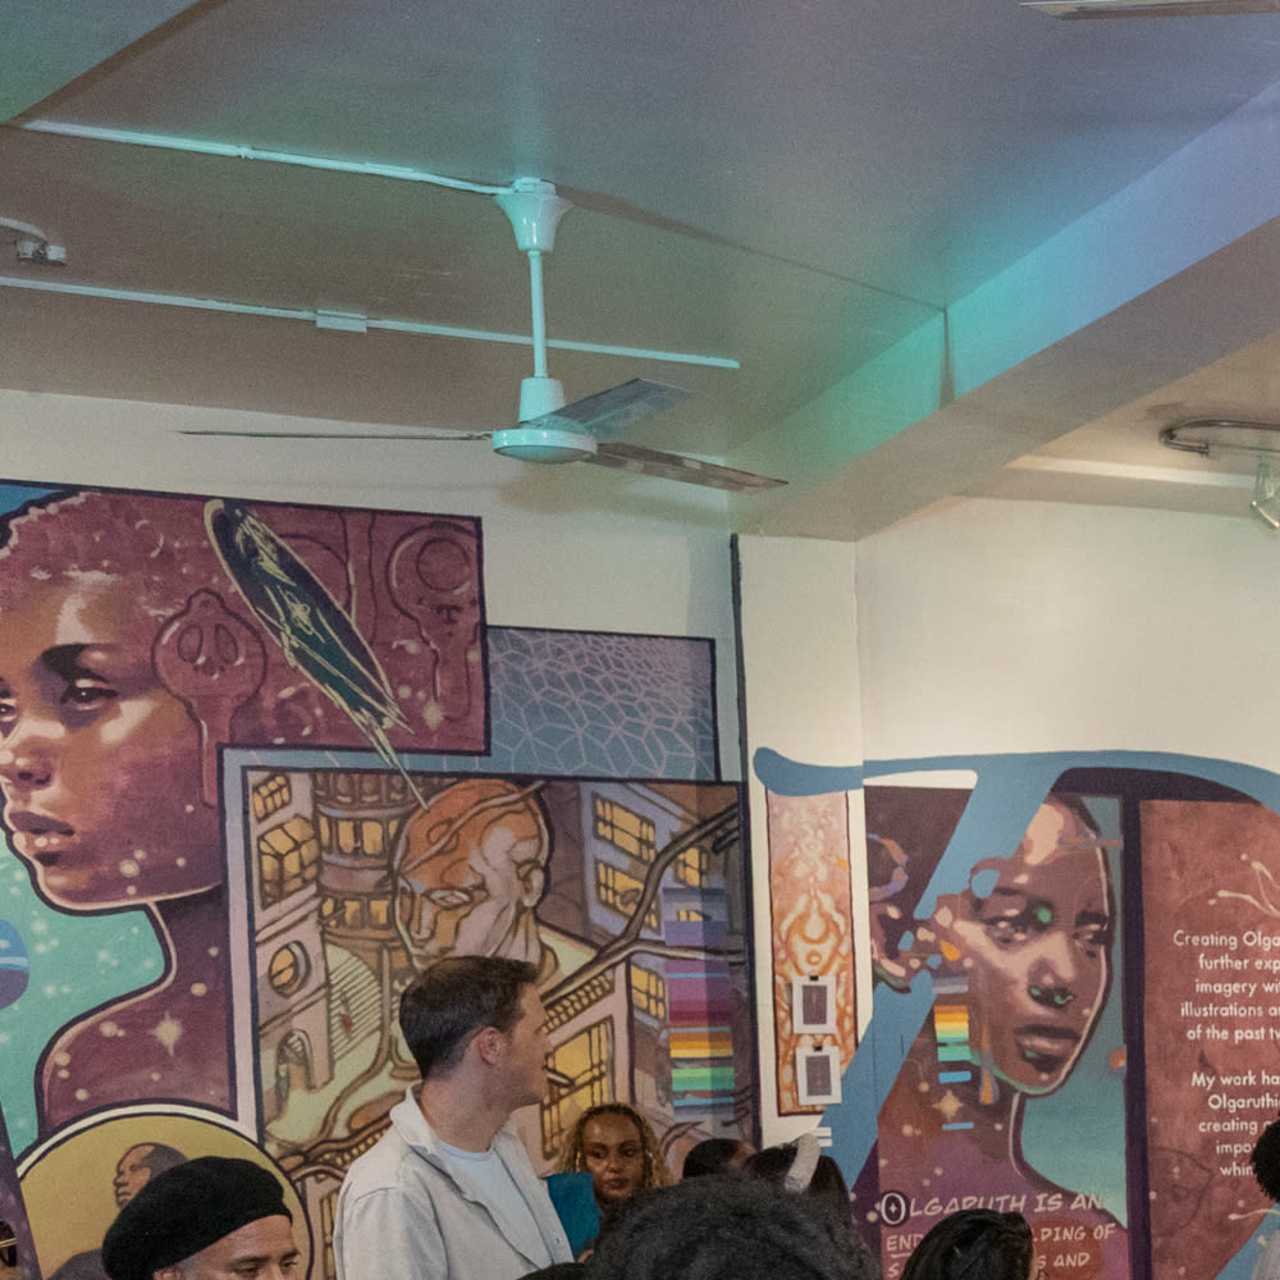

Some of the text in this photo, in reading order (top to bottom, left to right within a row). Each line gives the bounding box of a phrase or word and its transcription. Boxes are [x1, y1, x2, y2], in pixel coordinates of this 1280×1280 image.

[1173, 930, 1238, 950] Creating
[1198, 952, 1249, 972] further
[1195, 978, 1257, 998] imagery
[1180, 1000, 1263, 1018] illustrations
[1186, 1023, 1203, 1041] of
[1206, 1023, 1229, 1041] the
[1234, 1024, 1265, 1042] past
[1191, 1071, 1217, 1091] My
[1220, 1070, 1256, 1087] work
[1198, 1116, 1258, 1138] creating
[1034, 1194, 1062, 1210] IS
[1070, 1193, 1100, 1210] AN
[1093, 1223, 1116, 1241] OF
[1053, 1252, 1091, 1268] AND
